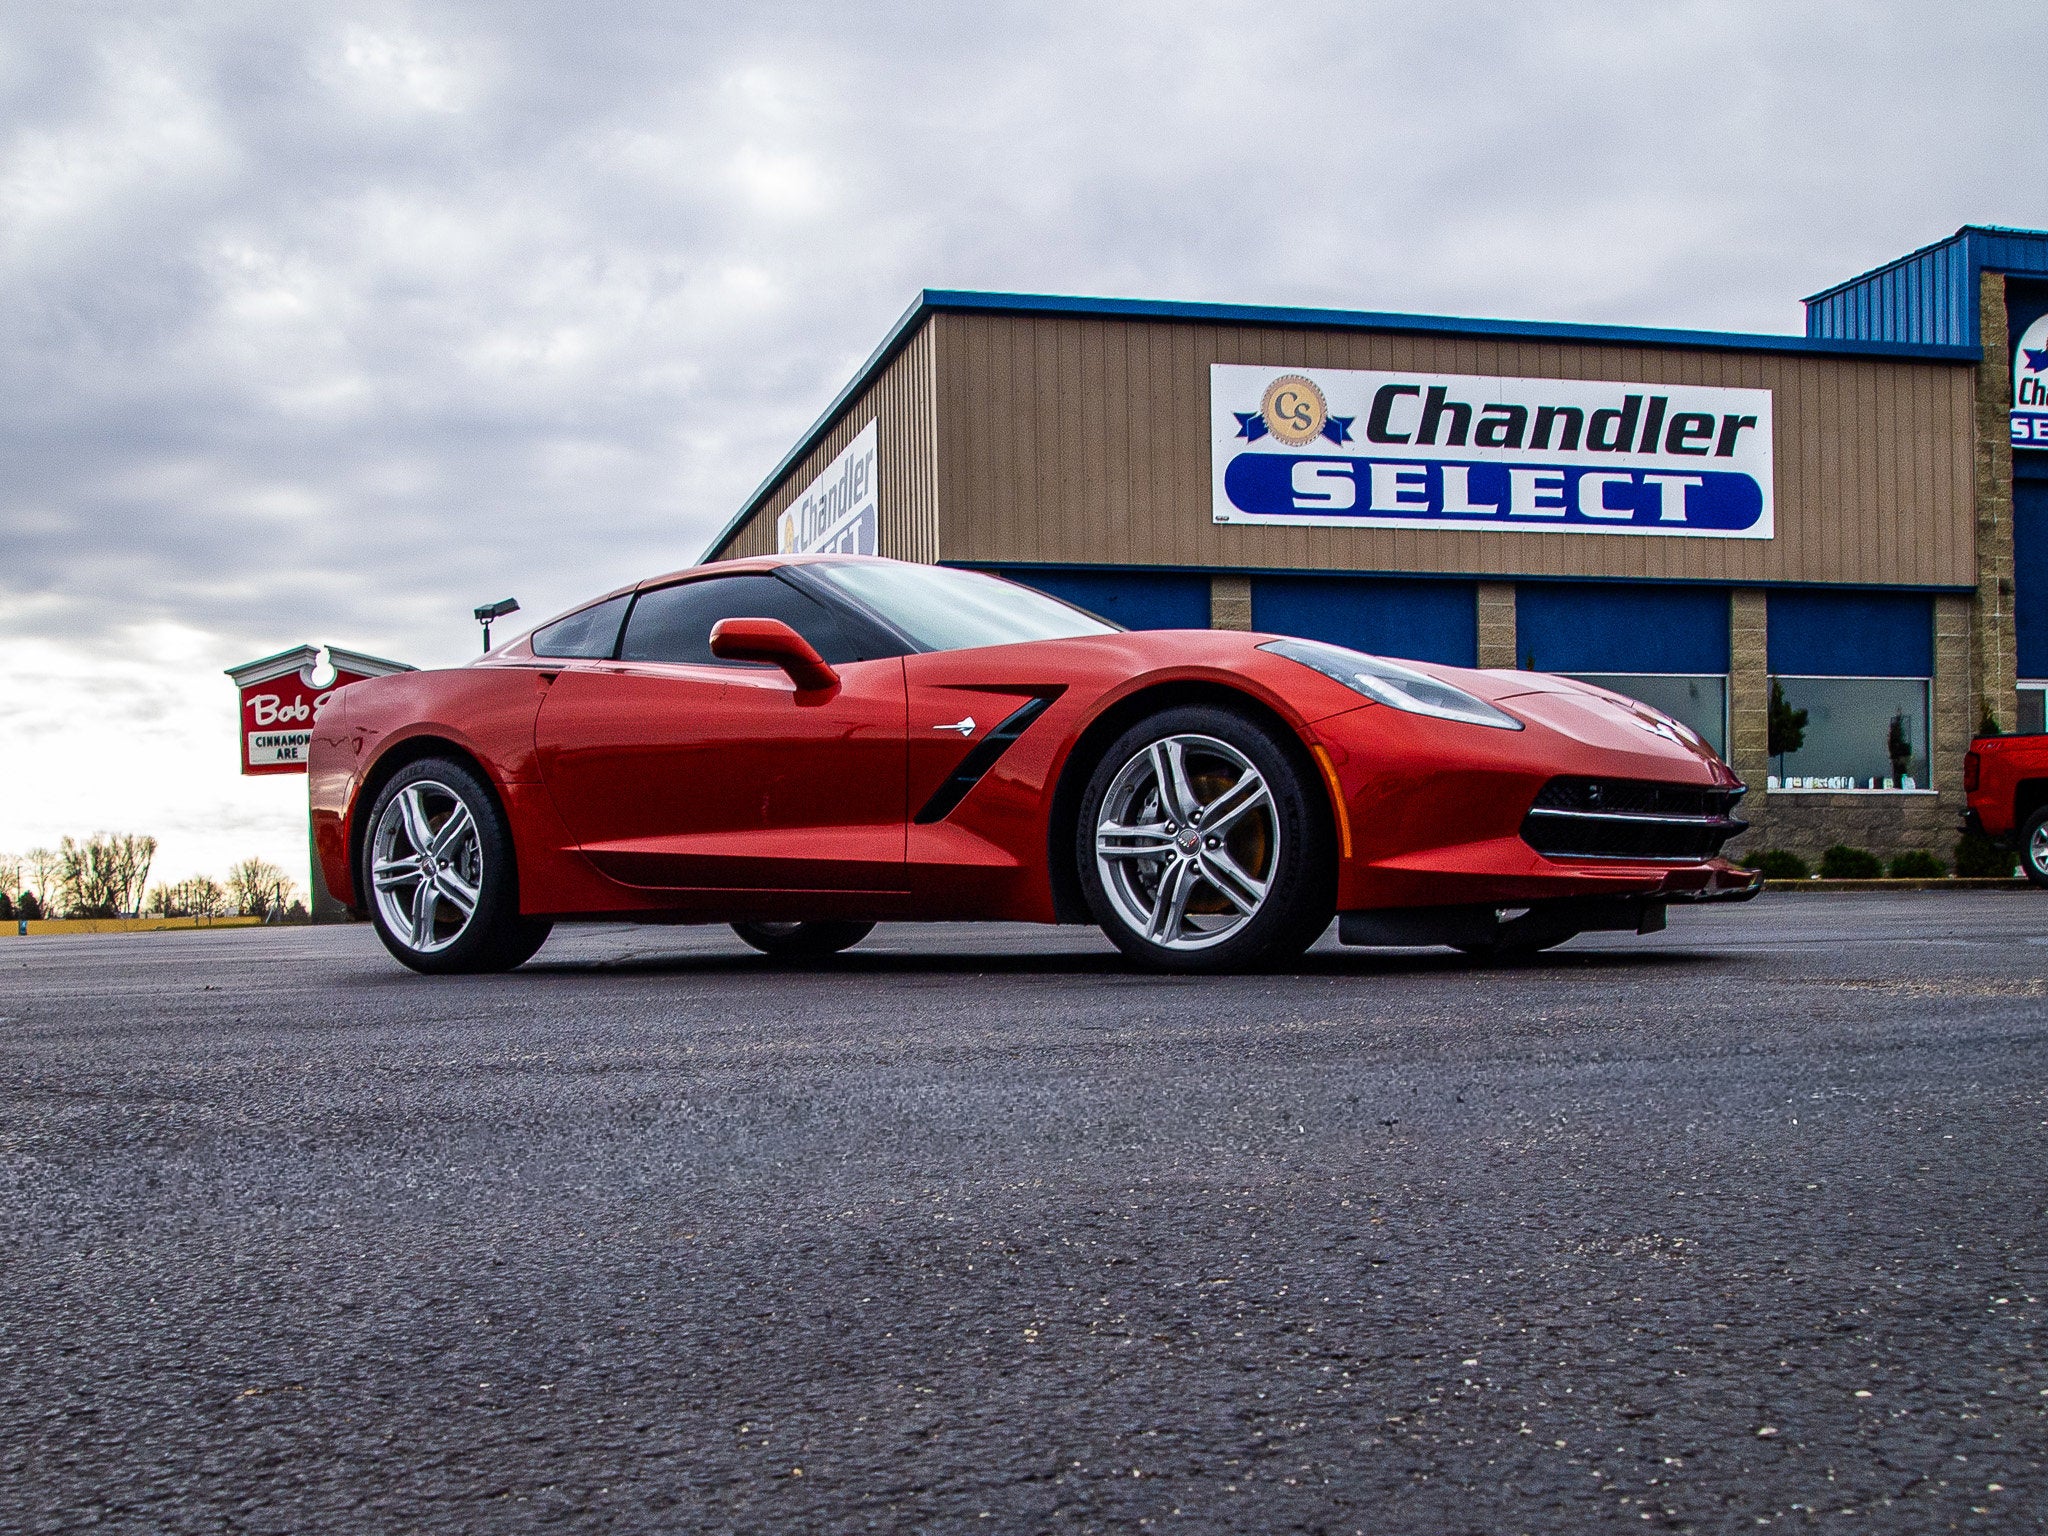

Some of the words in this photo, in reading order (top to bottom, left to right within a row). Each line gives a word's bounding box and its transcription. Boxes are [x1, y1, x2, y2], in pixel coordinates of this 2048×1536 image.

[2018, 377, 2048, 406] Ch
[1275, 391, 1312, 431] CS
[1366, 384, 1757, 457] Chandler
[800, 448, 873, 551] Chandler
[1291, 460, 1703, 522] SELECT
[246, 694, 310, 726] Bob
[255, 734, 311, 748] CINNAMON
[276, 747, 299, 760] ARE
